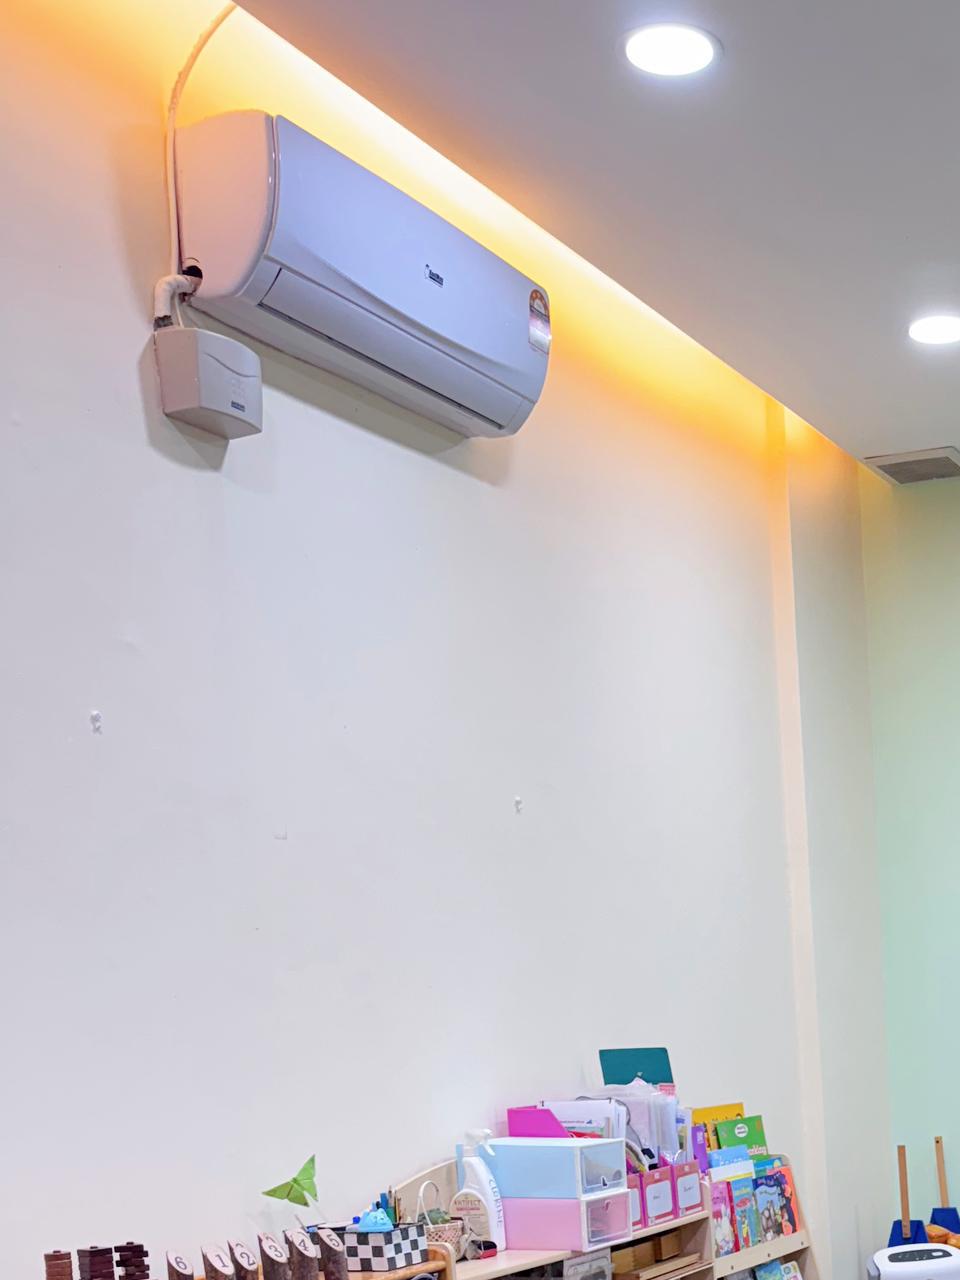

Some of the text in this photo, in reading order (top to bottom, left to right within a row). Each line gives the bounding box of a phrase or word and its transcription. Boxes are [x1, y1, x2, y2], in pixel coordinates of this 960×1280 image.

[298, 1238, 310, 1253] 4
[326, 1233, 340, 1248] 5
[240, 1251, 256, 1267] 2
[268, 1244, 284, 1259] 3
[174, 1256, 188, 1271] 6
[215, 1253, 229, 1269] 1
